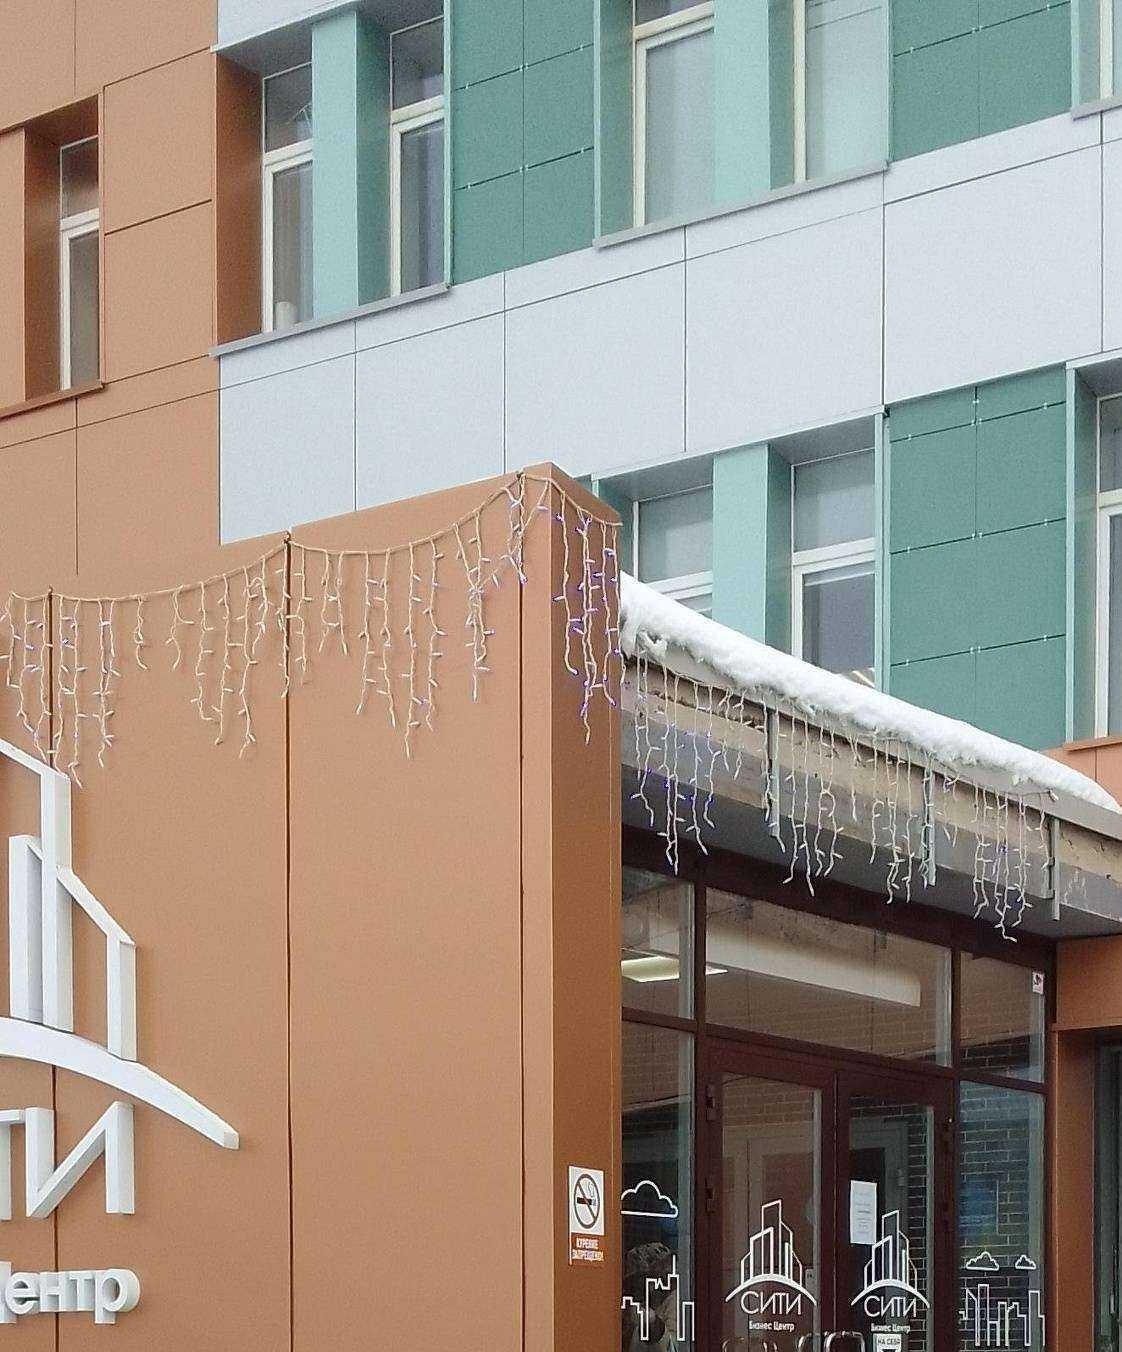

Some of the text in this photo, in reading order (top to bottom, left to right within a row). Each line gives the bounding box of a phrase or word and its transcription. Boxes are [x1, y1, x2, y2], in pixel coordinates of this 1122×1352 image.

[740, 1290, 802, 1315] СИТИ
[864, 1295, 917, 1318] СИТИ
[749, 1320, 795, 1333] Бизнес Центр
